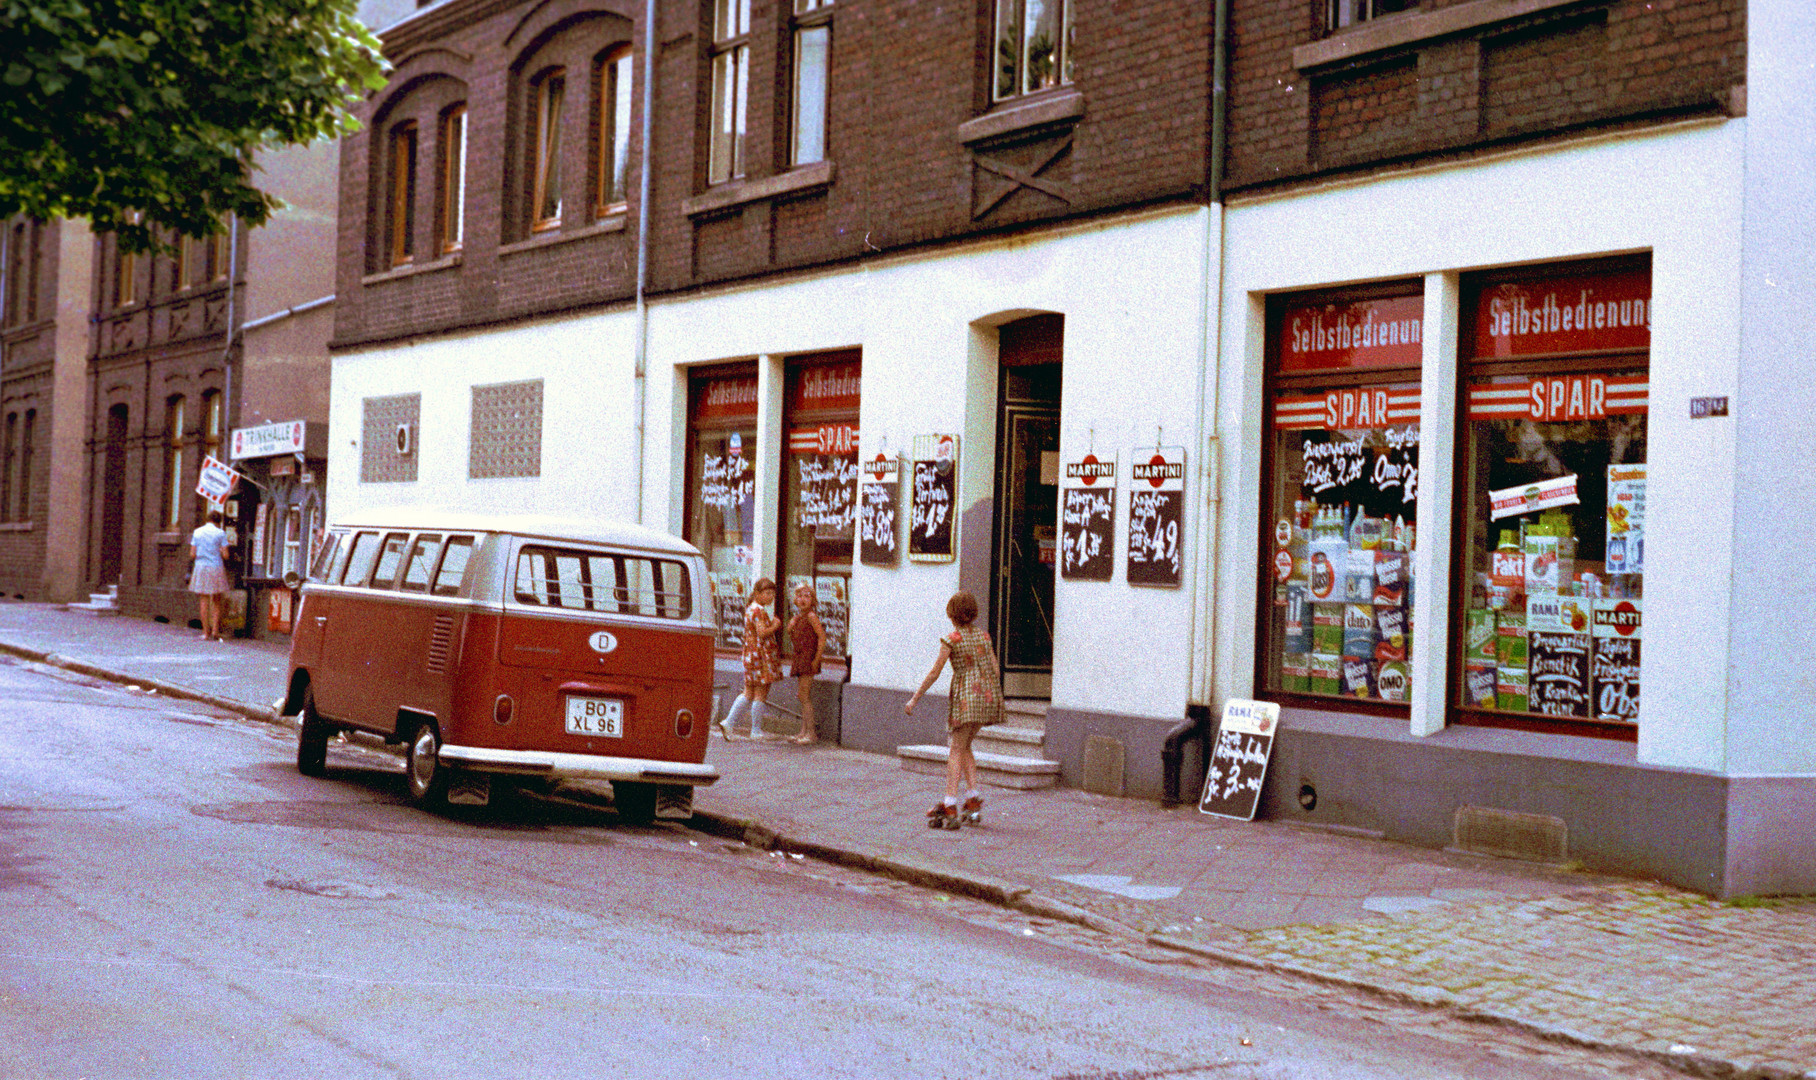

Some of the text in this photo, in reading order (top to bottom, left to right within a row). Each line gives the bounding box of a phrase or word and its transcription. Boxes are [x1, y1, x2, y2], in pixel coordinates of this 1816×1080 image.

[1292, 310, 1423, 353] Selbstbedienun
[1531, 379, 1605, 418] SPAR
[1326, 391, 1388, 427] SPAR
[818, 426, 852, 452] SPAR
[865, 460, 897, 473] MARTINI
[1068, 463, 1113, 476] MARTINI
[1134, 464, 1181, 478] MARTINI
[1493, 553, 1524, 577] Fakt
[1531, 603, 1559, 616] RAMA
[1347, 610, 1371, 629] dato
[1596, 611, 1641, 625] MARTI
[599, 635, 609, 649] D
[1380, 675, 1403, 690] OMO
[586, 701, 606, 717] BO
[573, 716, 615, 732] XL 96
